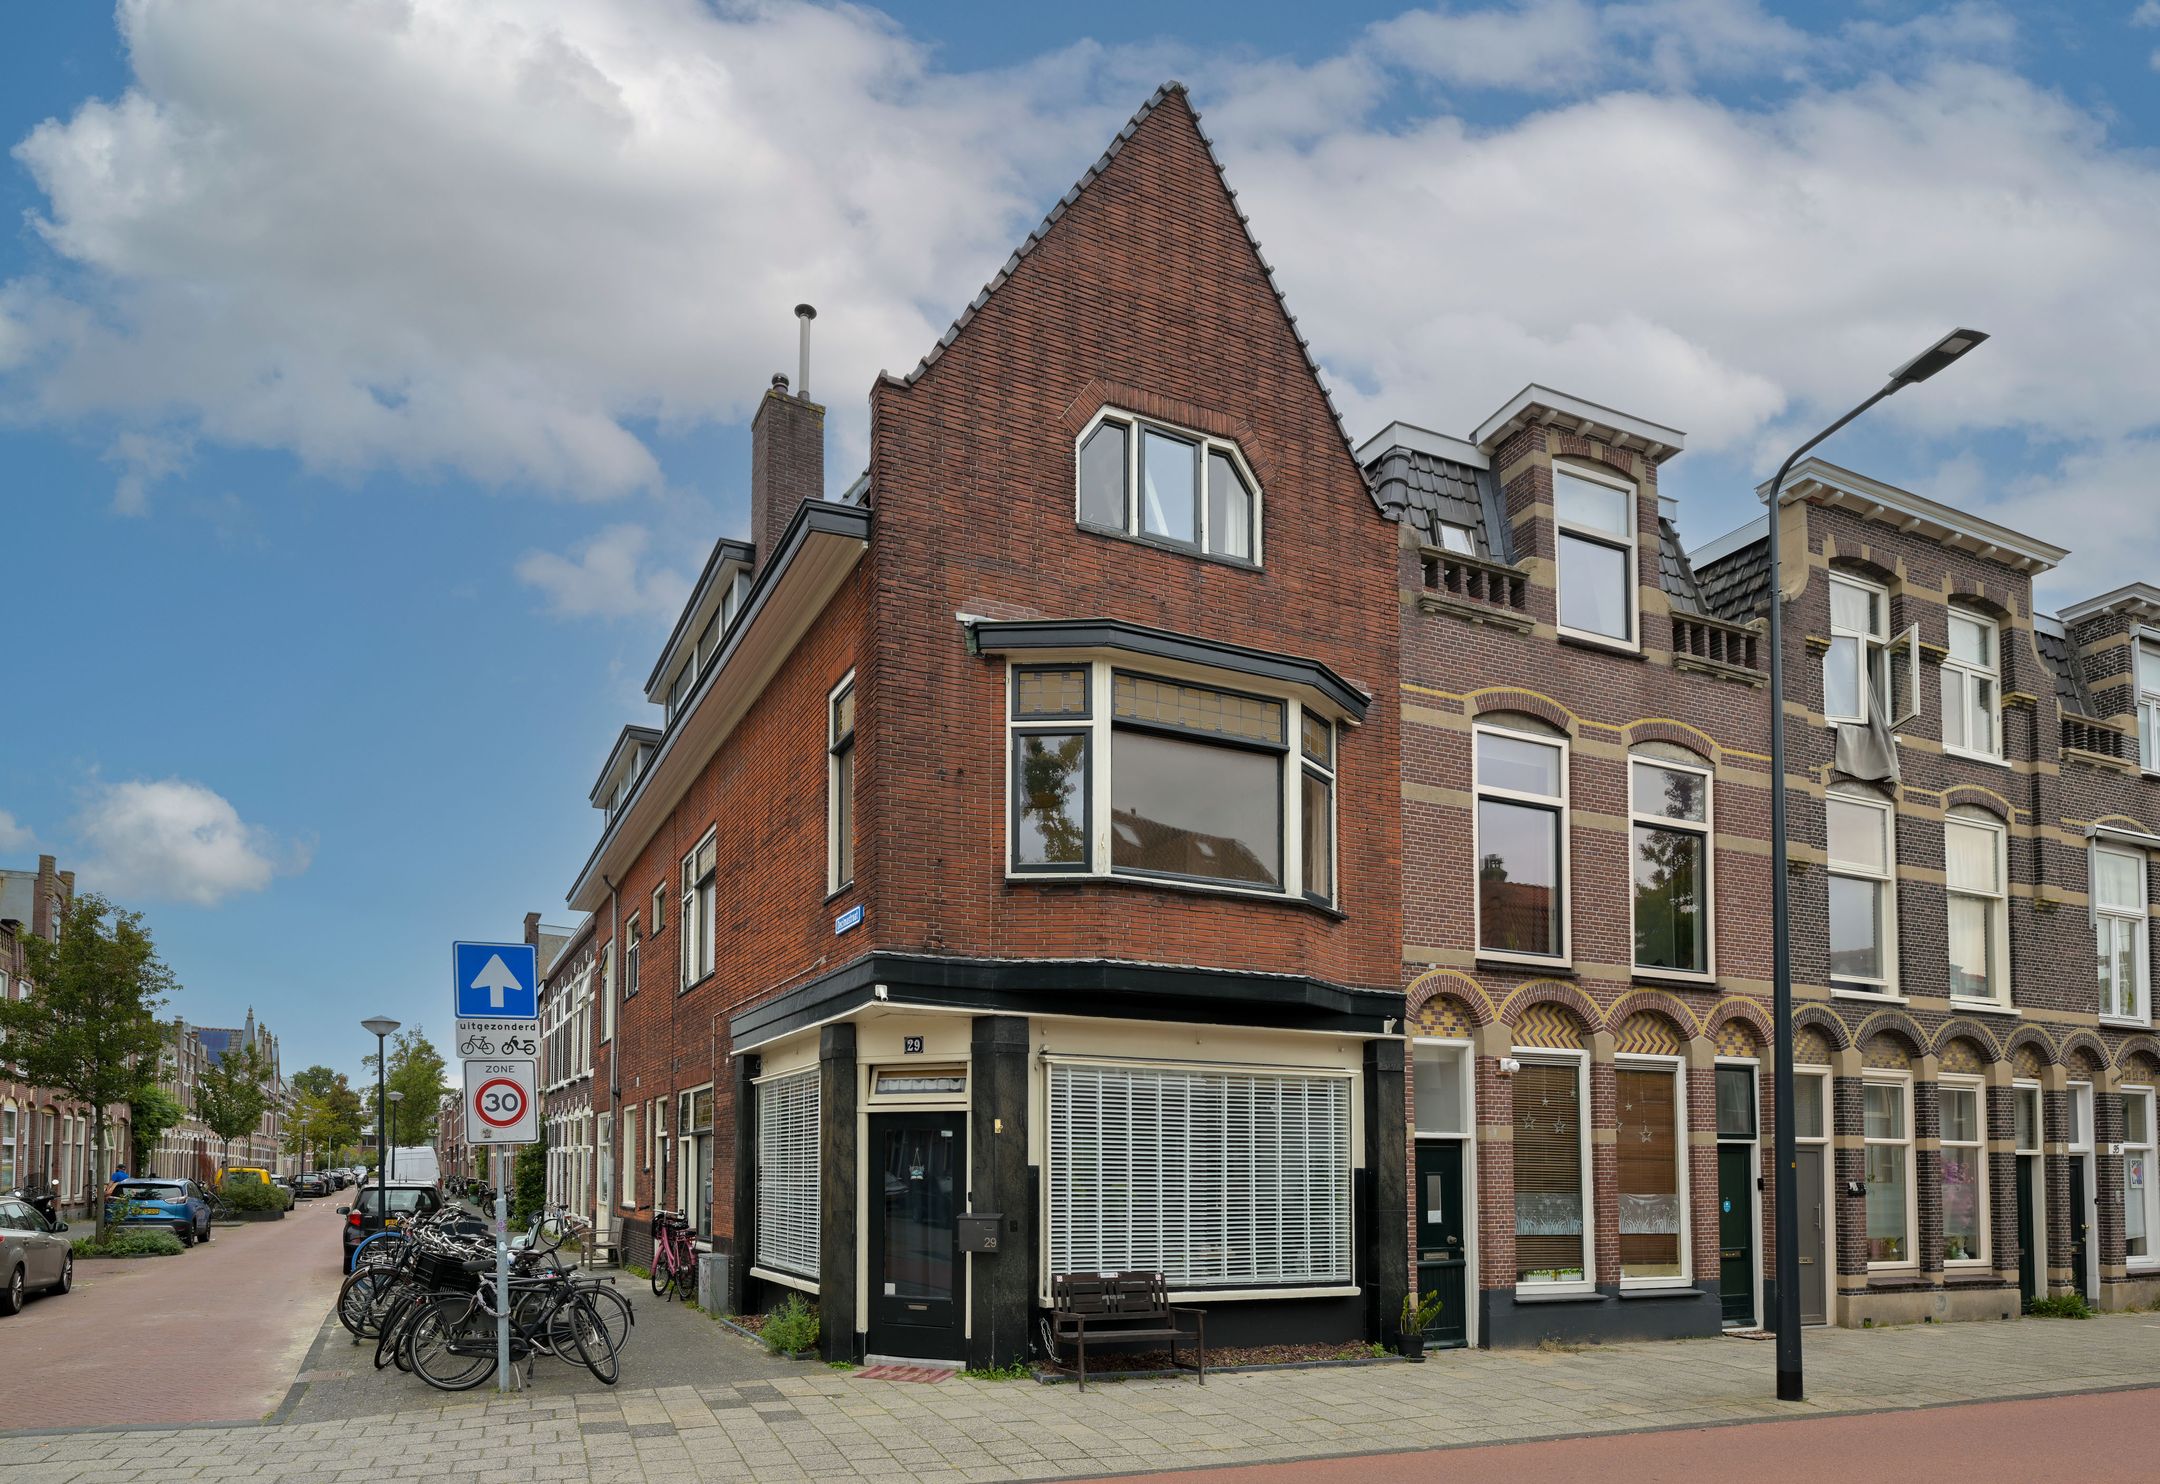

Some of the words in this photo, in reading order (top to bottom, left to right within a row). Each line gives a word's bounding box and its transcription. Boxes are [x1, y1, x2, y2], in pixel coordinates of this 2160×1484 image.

[460, 1022, 536, 1032] uitgezonderd
[907, 1039, 920, 1051] 29
[485, 1065, 515, 1073] ZONE
[484, 1093, 518, 1112] 30
[984, 1237, 997, 1248] 29
